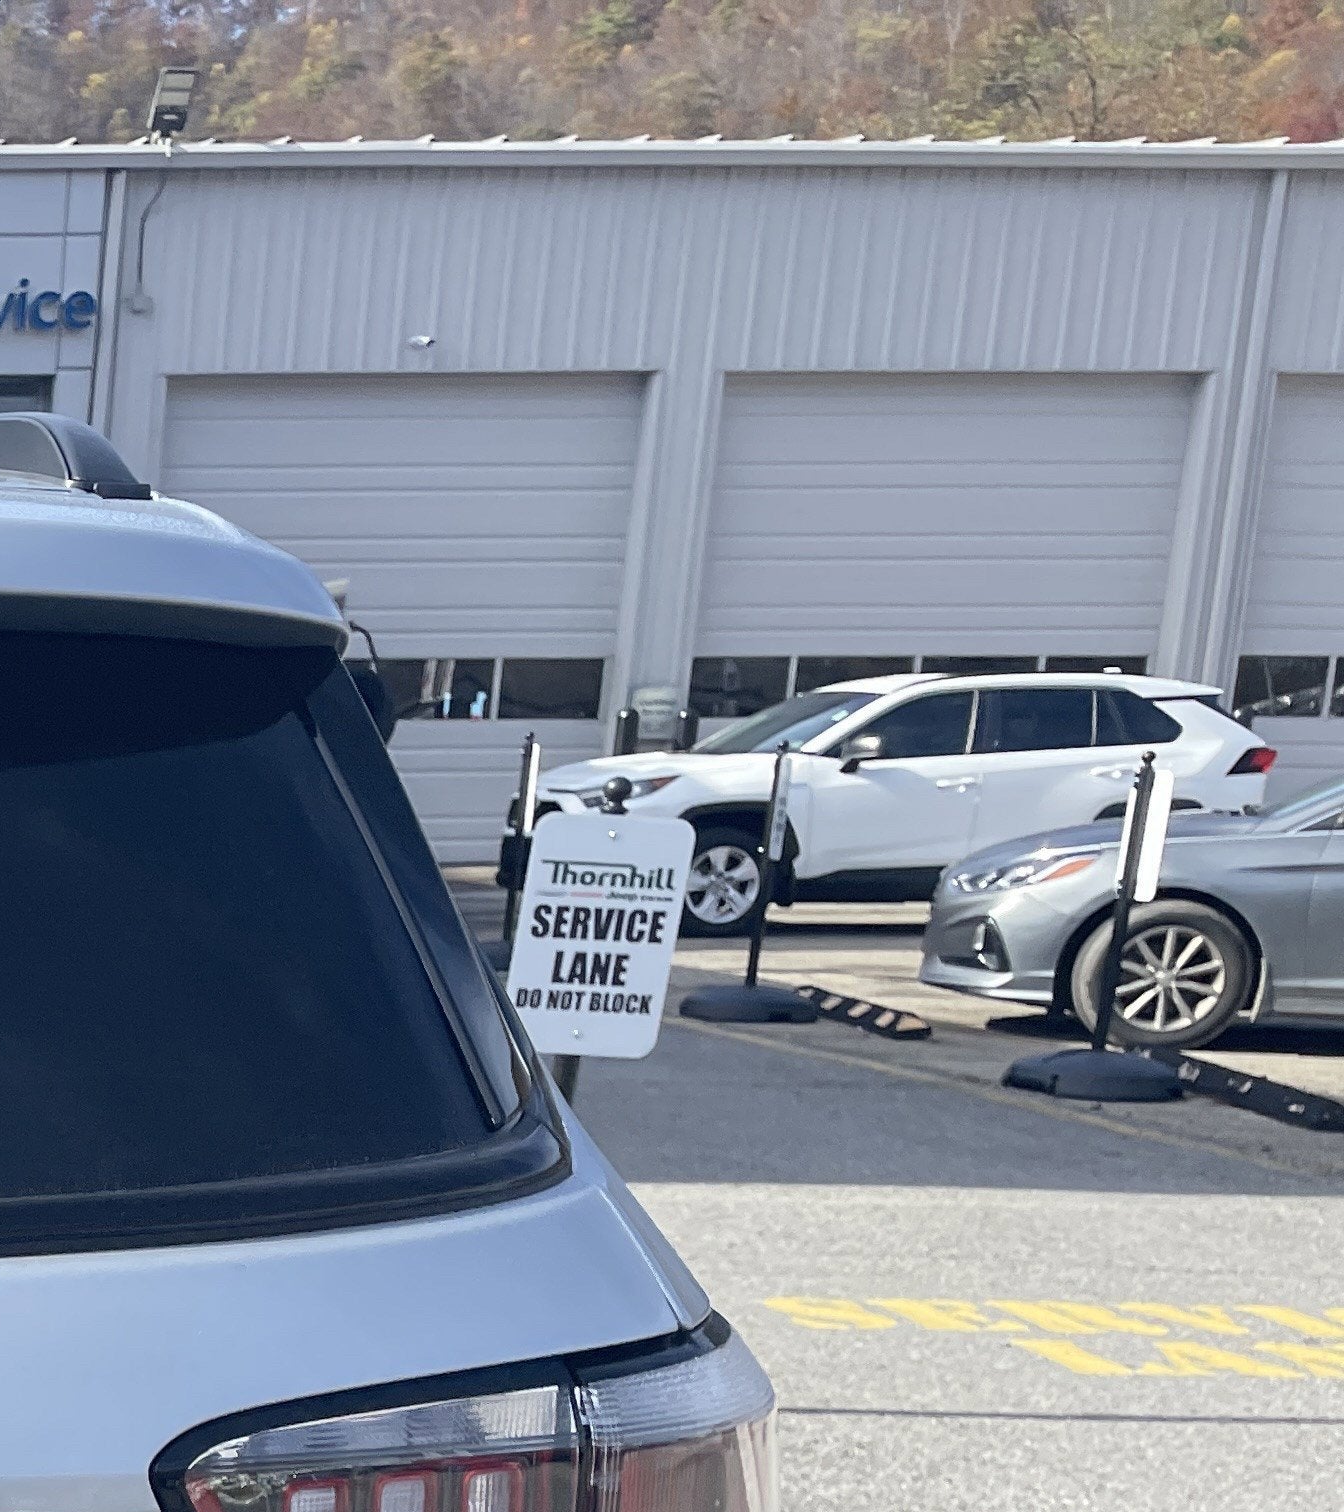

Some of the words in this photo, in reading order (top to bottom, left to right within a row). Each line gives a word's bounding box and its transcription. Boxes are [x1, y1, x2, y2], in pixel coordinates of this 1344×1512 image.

[541, 859, 676, 891] Thornhill
[531, 904, 667, 943] SERVICE
[551, 951, 631, 986] LANE
[516, 988, 542, 1009] DO
[546, 989, 586, 1012] NOT
[589, 992, 653, 1014] BLOCK
[763, 1296, 1344, 1337] SERVI
